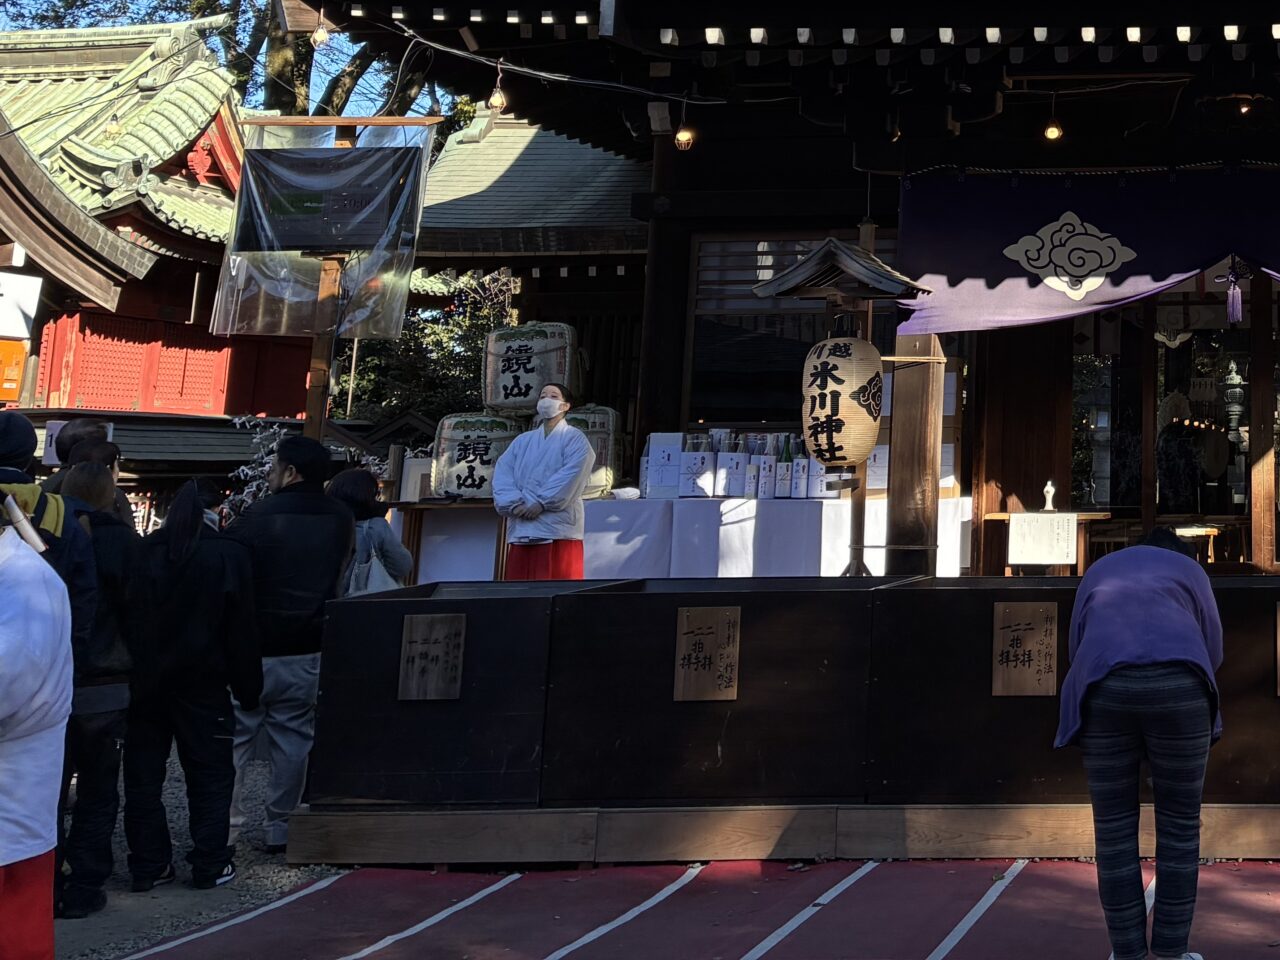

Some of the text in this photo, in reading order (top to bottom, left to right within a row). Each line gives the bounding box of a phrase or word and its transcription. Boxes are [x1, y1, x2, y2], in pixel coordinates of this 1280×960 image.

[501, 345, 535, 400] 鏡山
[808, 343, 853, 359] 川越
[807, 361, 848, 462] 氷川神社
[456, 435, 492, 490] 鏡山
